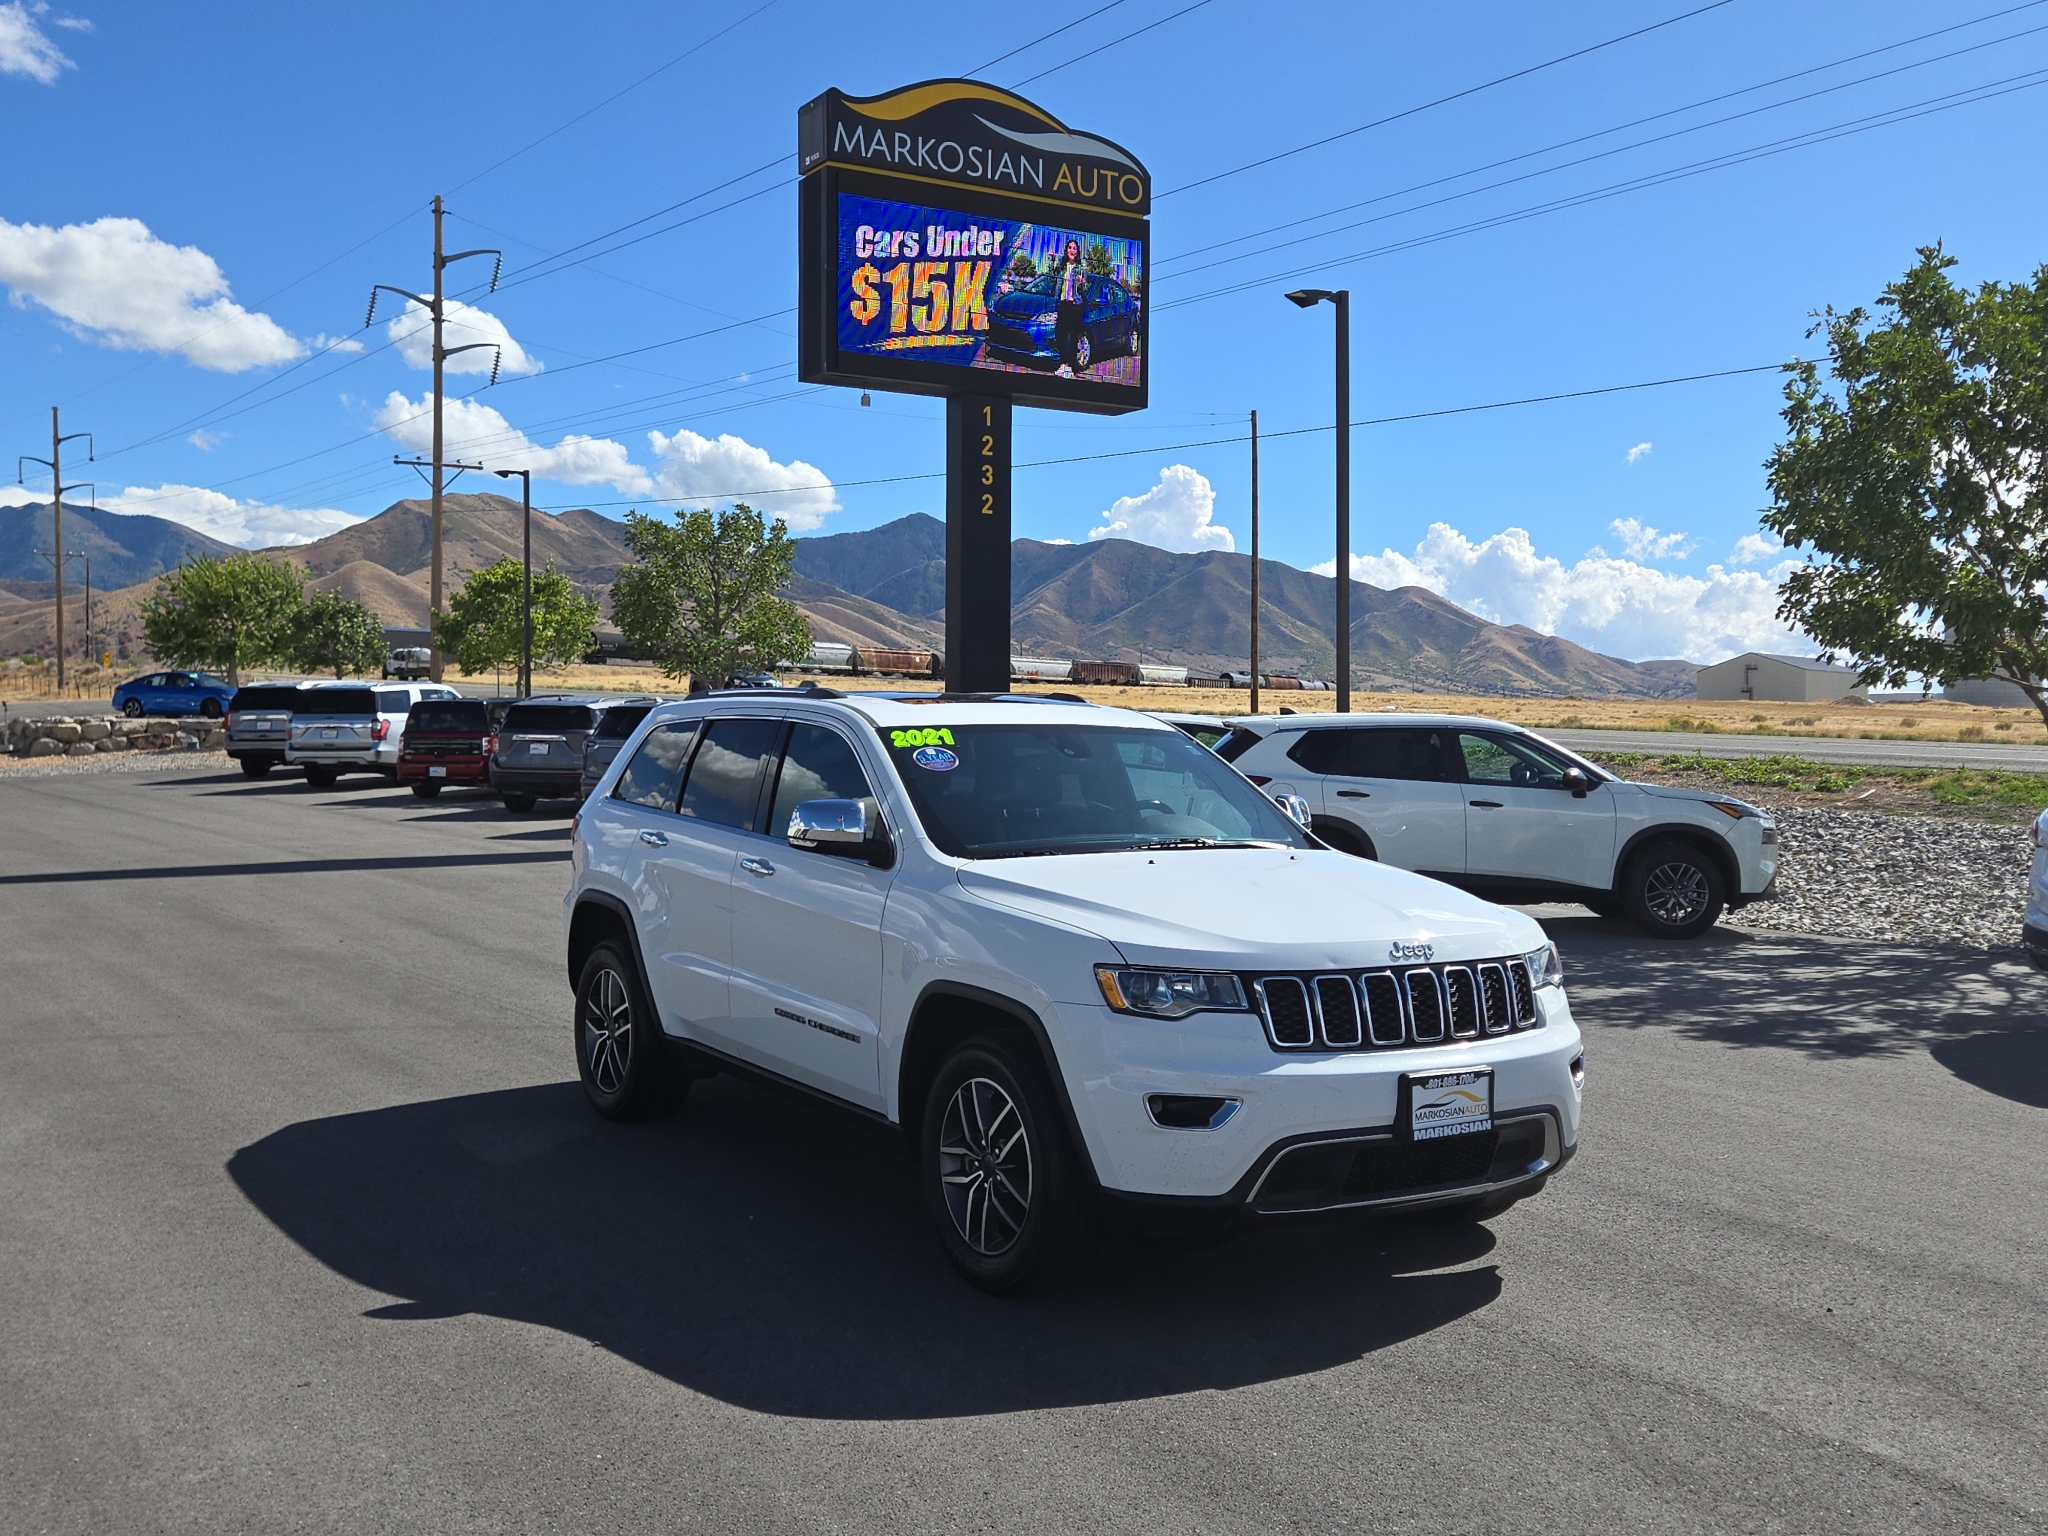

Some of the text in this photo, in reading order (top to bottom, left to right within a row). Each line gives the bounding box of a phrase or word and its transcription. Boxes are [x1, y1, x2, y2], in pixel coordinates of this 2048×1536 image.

[834, 121, 1143, 205] MARKOSIAN AUTO
[855, 225, 1005, 258] Cars Under
[850, 261, 990, 333] $15K
[890, 728, 955, 748] 2021
[1389, 941, 1435, 962] Jeep
[1413, 1119, 1491, 1141] MARKOSIAN
